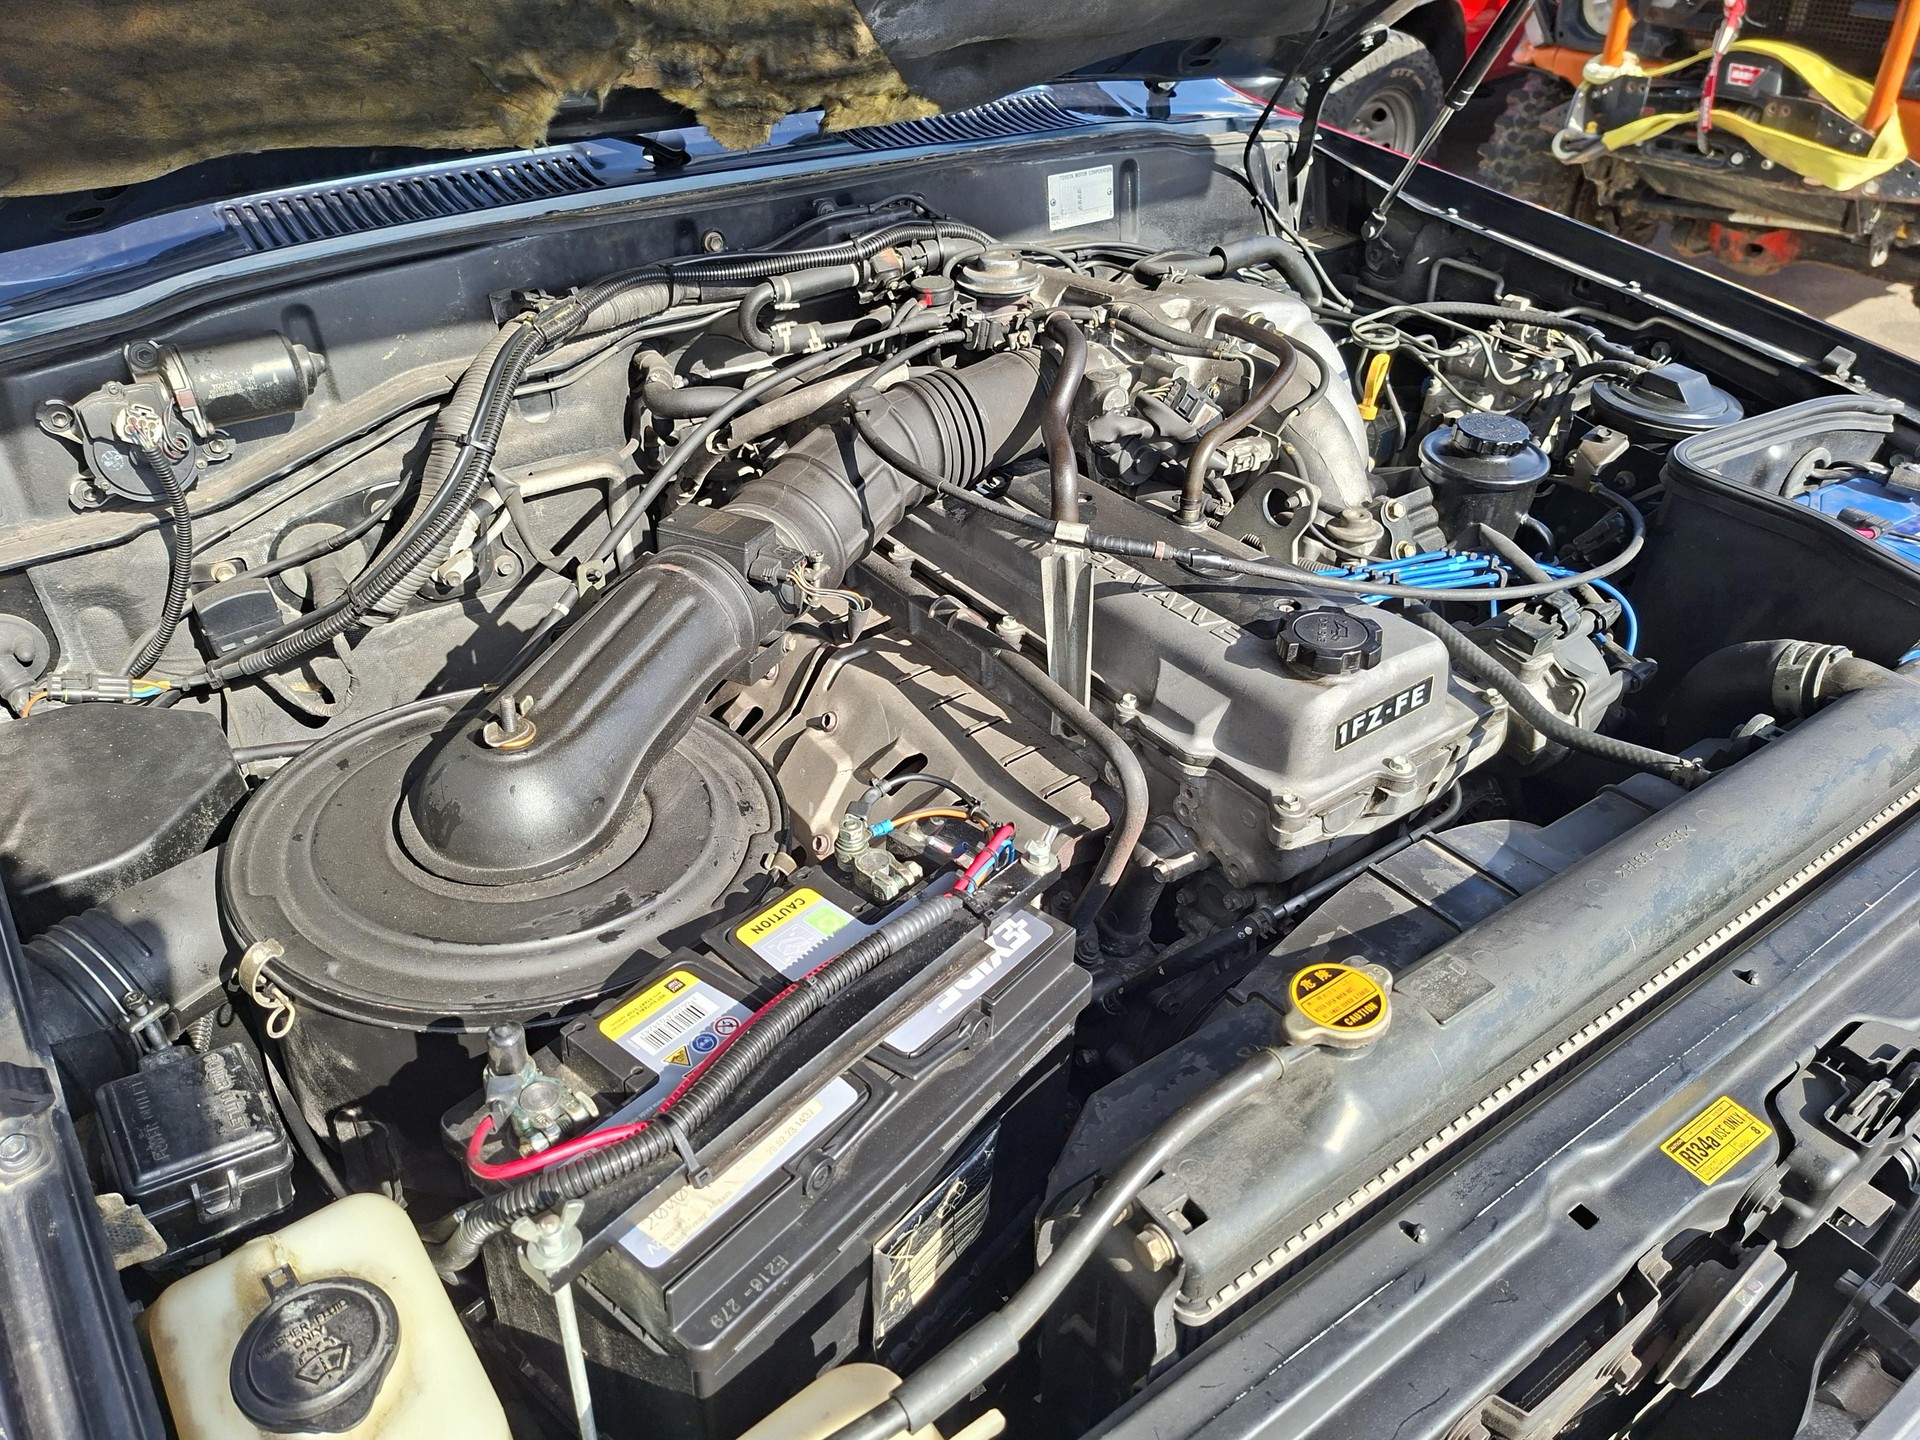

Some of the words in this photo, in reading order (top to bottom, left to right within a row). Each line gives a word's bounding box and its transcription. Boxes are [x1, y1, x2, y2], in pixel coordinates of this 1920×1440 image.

[211, 379, 239, 390] TOYOTA
[1132, 573, 1243, 646] VALVE
[1339, 683, 1426, 745] 1FZ-FE
[750, 897, 806, 935] CAUTION
[1343, 1002, 1379, 1026] CAUTION
[203, 1052, 232, 1093] POWER
[220, 1092, 248, 1131] OUTLET
[1679, 1135, 1721, 1167] R134a
[1711, 1124, 1732, 1141] USE
[1723, 1111, 1746, 1131] ONLY
[1750, 1126, 1762, 1135] 8
[313, 1298, 349, 1327] FLUID
[709, 1297, 741, 1330] 279
[293, 1324, 325, 1350] ONLY
